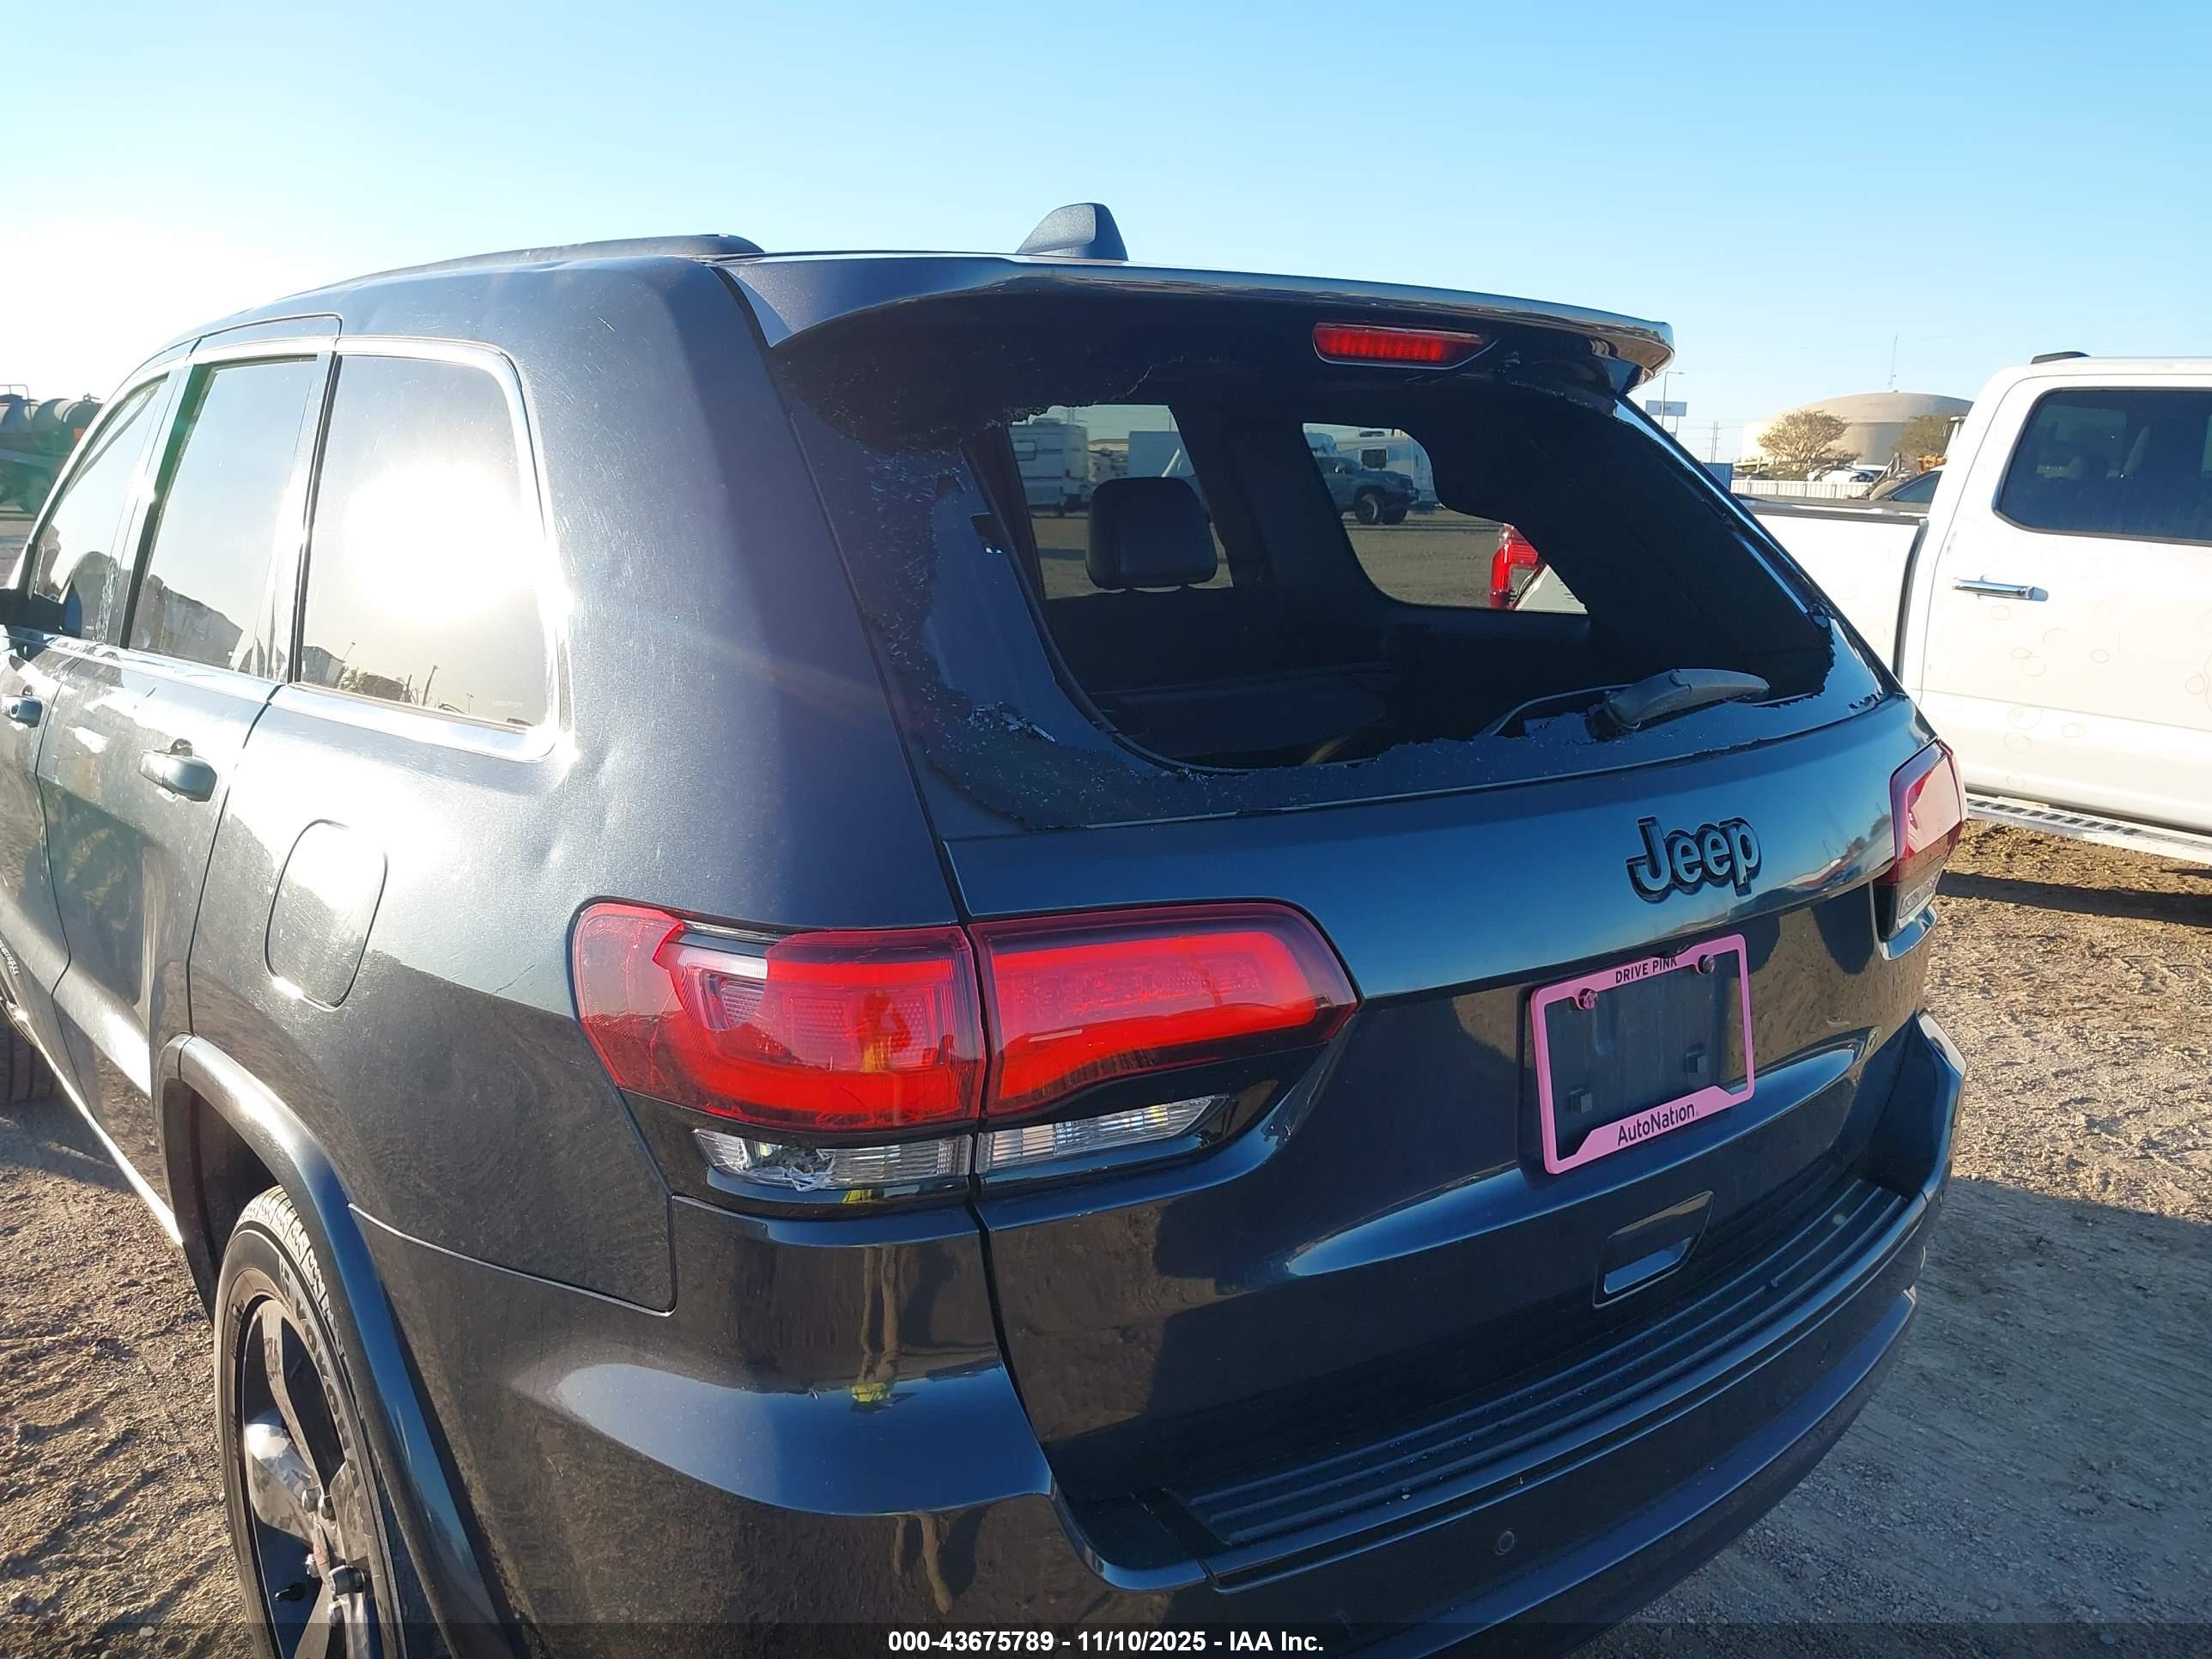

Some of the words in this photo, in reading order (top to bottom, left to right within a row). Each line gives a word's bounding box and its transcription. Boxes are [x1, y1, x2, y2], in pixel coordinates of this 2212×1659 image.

[1626, 816, 1762, 904] Jeep
[1615, 963, 1648, 983] DRIVE
[1652, 955, 1677, 973] PINK
[1618, 1103, 1695, 1146] AutoNation
